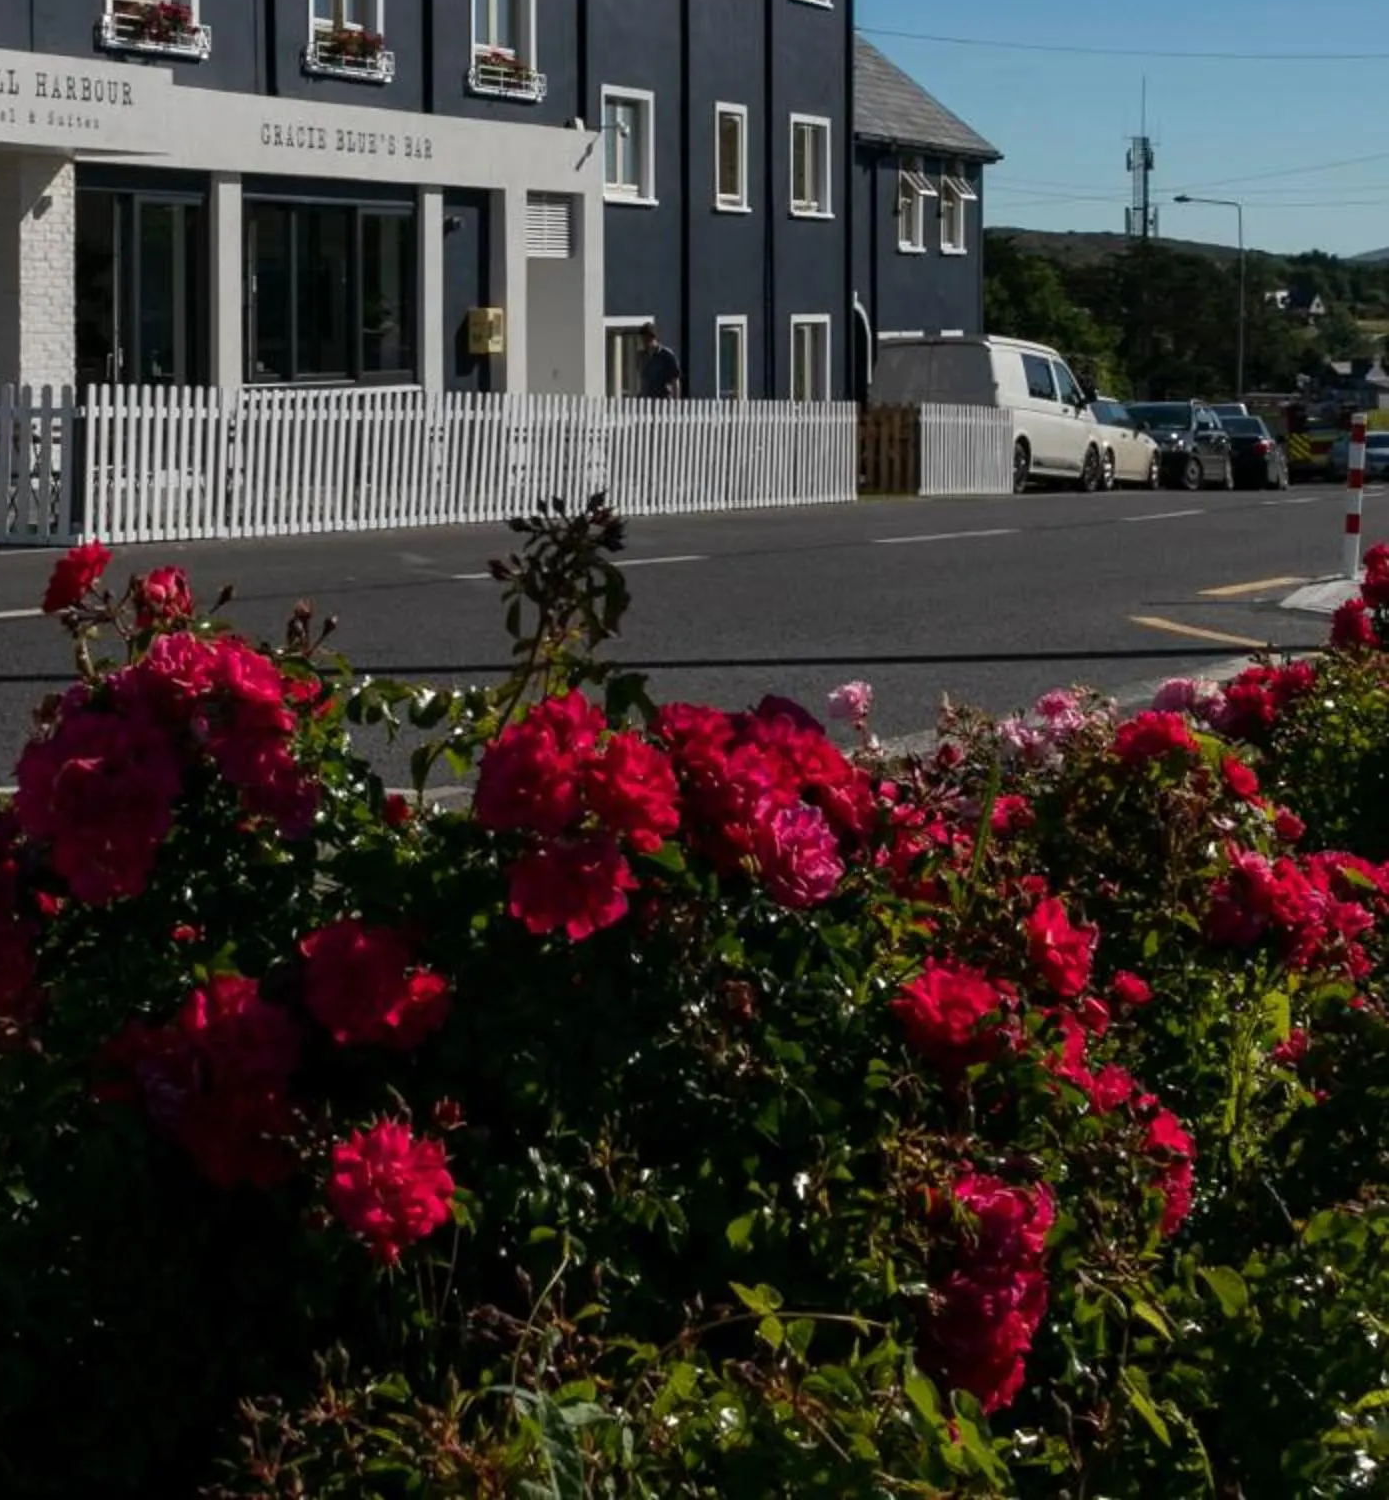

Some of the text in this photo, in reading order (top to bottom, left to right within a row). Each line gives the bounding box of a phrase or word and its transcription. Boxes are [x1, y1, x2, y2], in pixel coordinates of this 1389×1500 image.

[35, 72, 133, 105] HARBOUR
[47, 110, 100, 129] Suites
[262, 123, 433, 159] GRACIE BLUE'S BAR
